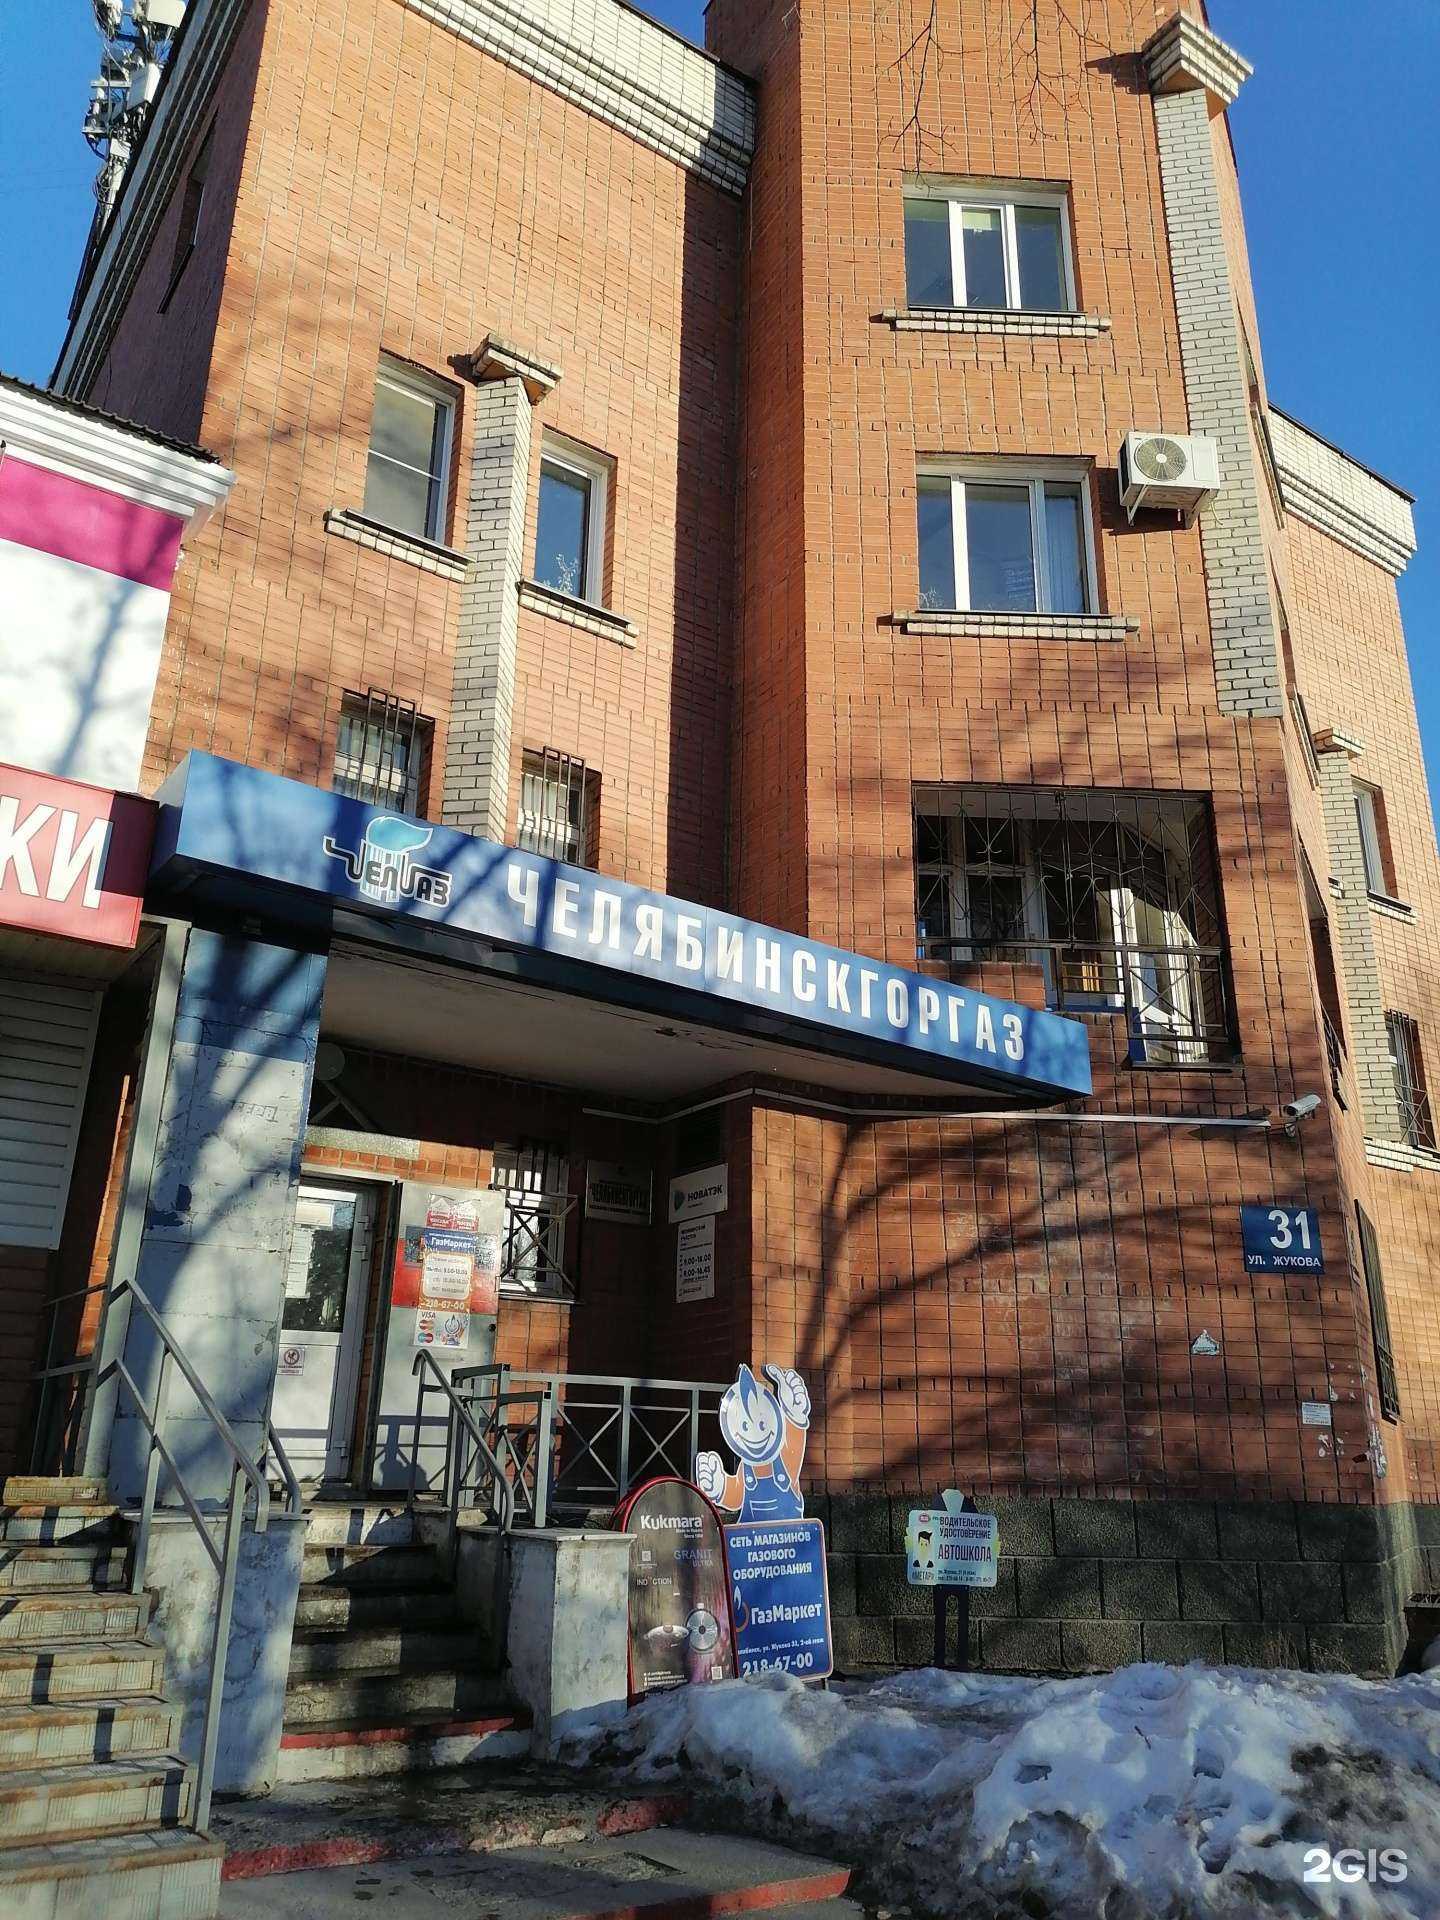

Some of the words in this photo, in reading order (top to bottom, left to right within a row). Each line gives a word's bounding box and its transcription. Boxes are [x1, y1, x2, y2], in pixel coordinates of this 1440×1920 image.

[0, 795, 114, 909] КИ
[507, 863, 1025, 1062] ЧЕЛЯБИНСКГОРГАЗ
[687, 1184, 723, 1201] НОВАТЭК
[1268, 1209, 1311, 1249] 31
[1247, 1255, 1266, 1265] УЛ.
[1273, 1255, 1321, 1267] ЖУКОВА
[421, 1311, 436, 1319] VISA
[640, 1514, 703, 1530] Kukmara
[940, 1516, 991, 1528] ВОДИТЕЛЬСКОЕ
[730, 1536, 751, 1548] СЕТЬ
[754, 1531, 811, 1546] МАГАЗИНОВ
[940, 1527, 991, 1539] УДОСТОВЕРЕНИЕ
[674, 1549, 713, 1560] GRANIT
[748, 1548, 796, 1563] ГАЗОВОГО
[938, 1544, 992, 1562] АВТОШКОЛА
[733, 1562, 812, 1580] ОБОРУДОВАНИЯ
[751, 1603, 822, 1625] ГазМаркет
[742, 1653, 814, 1677] 218-67-00
